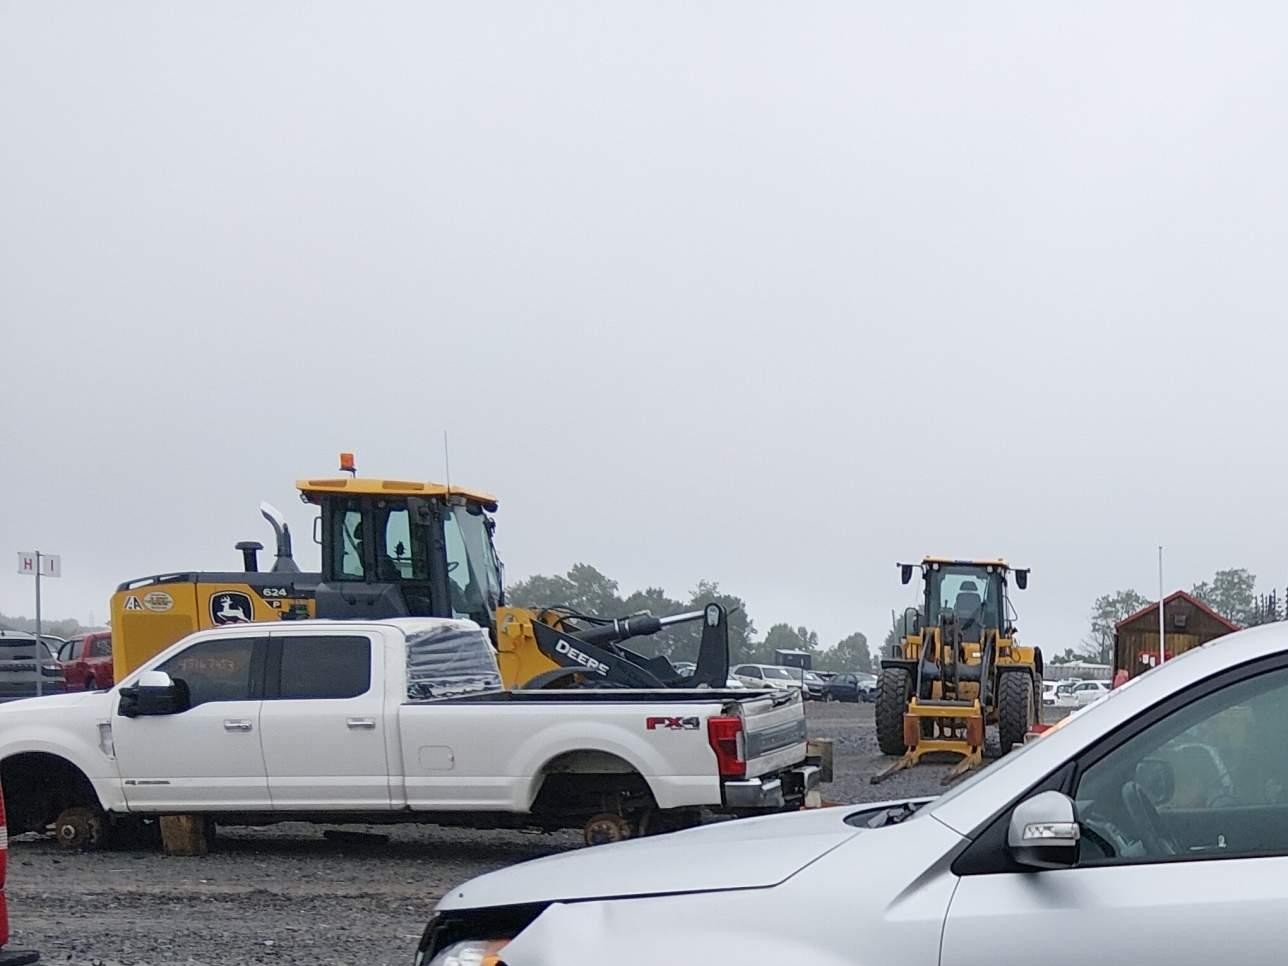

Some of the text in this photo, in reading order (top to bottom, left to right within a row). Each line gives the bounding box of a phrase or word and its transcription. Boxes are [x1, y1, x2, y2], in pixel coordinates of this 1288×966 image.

[24, 558, 33, 570] H
[263, 588, 287, 597] 624
[555, 638, 610, 676] DEERE
[646, 716, 700, 730] FX4
